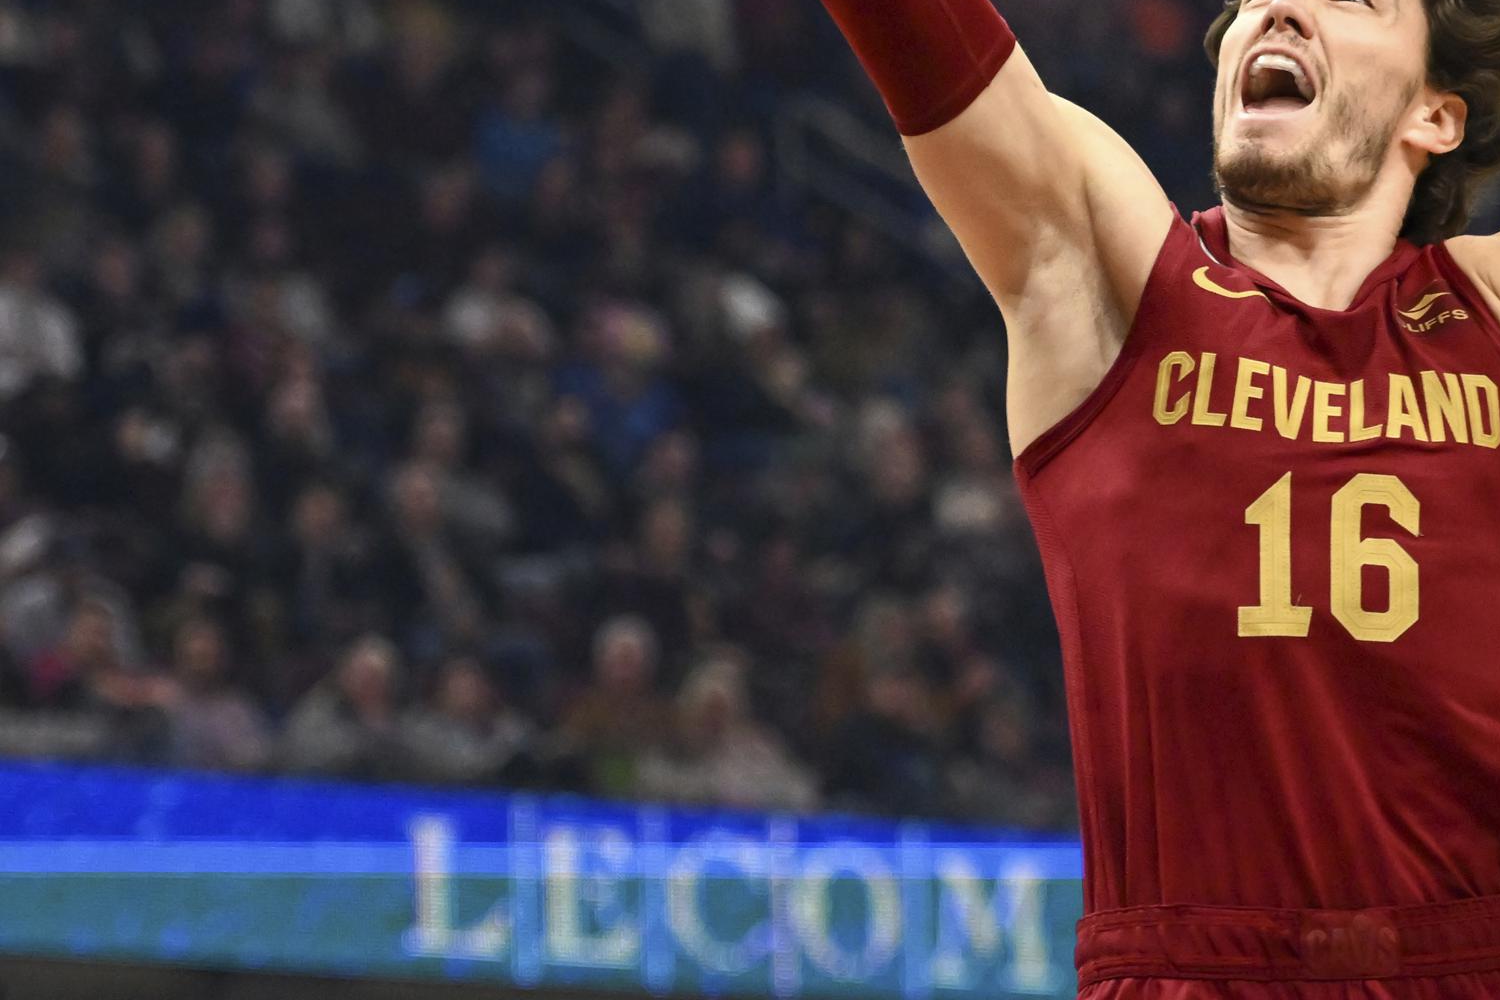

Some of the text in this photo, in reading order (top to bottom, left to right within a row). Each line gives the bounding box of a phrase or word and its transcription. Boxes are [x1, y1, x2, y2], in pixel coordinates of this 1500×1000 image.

[1402, 308, 1469, 333] LIFFS
[1237, 470, 1422, 643] 16
[402, 812, 1056, 992] LECOM
